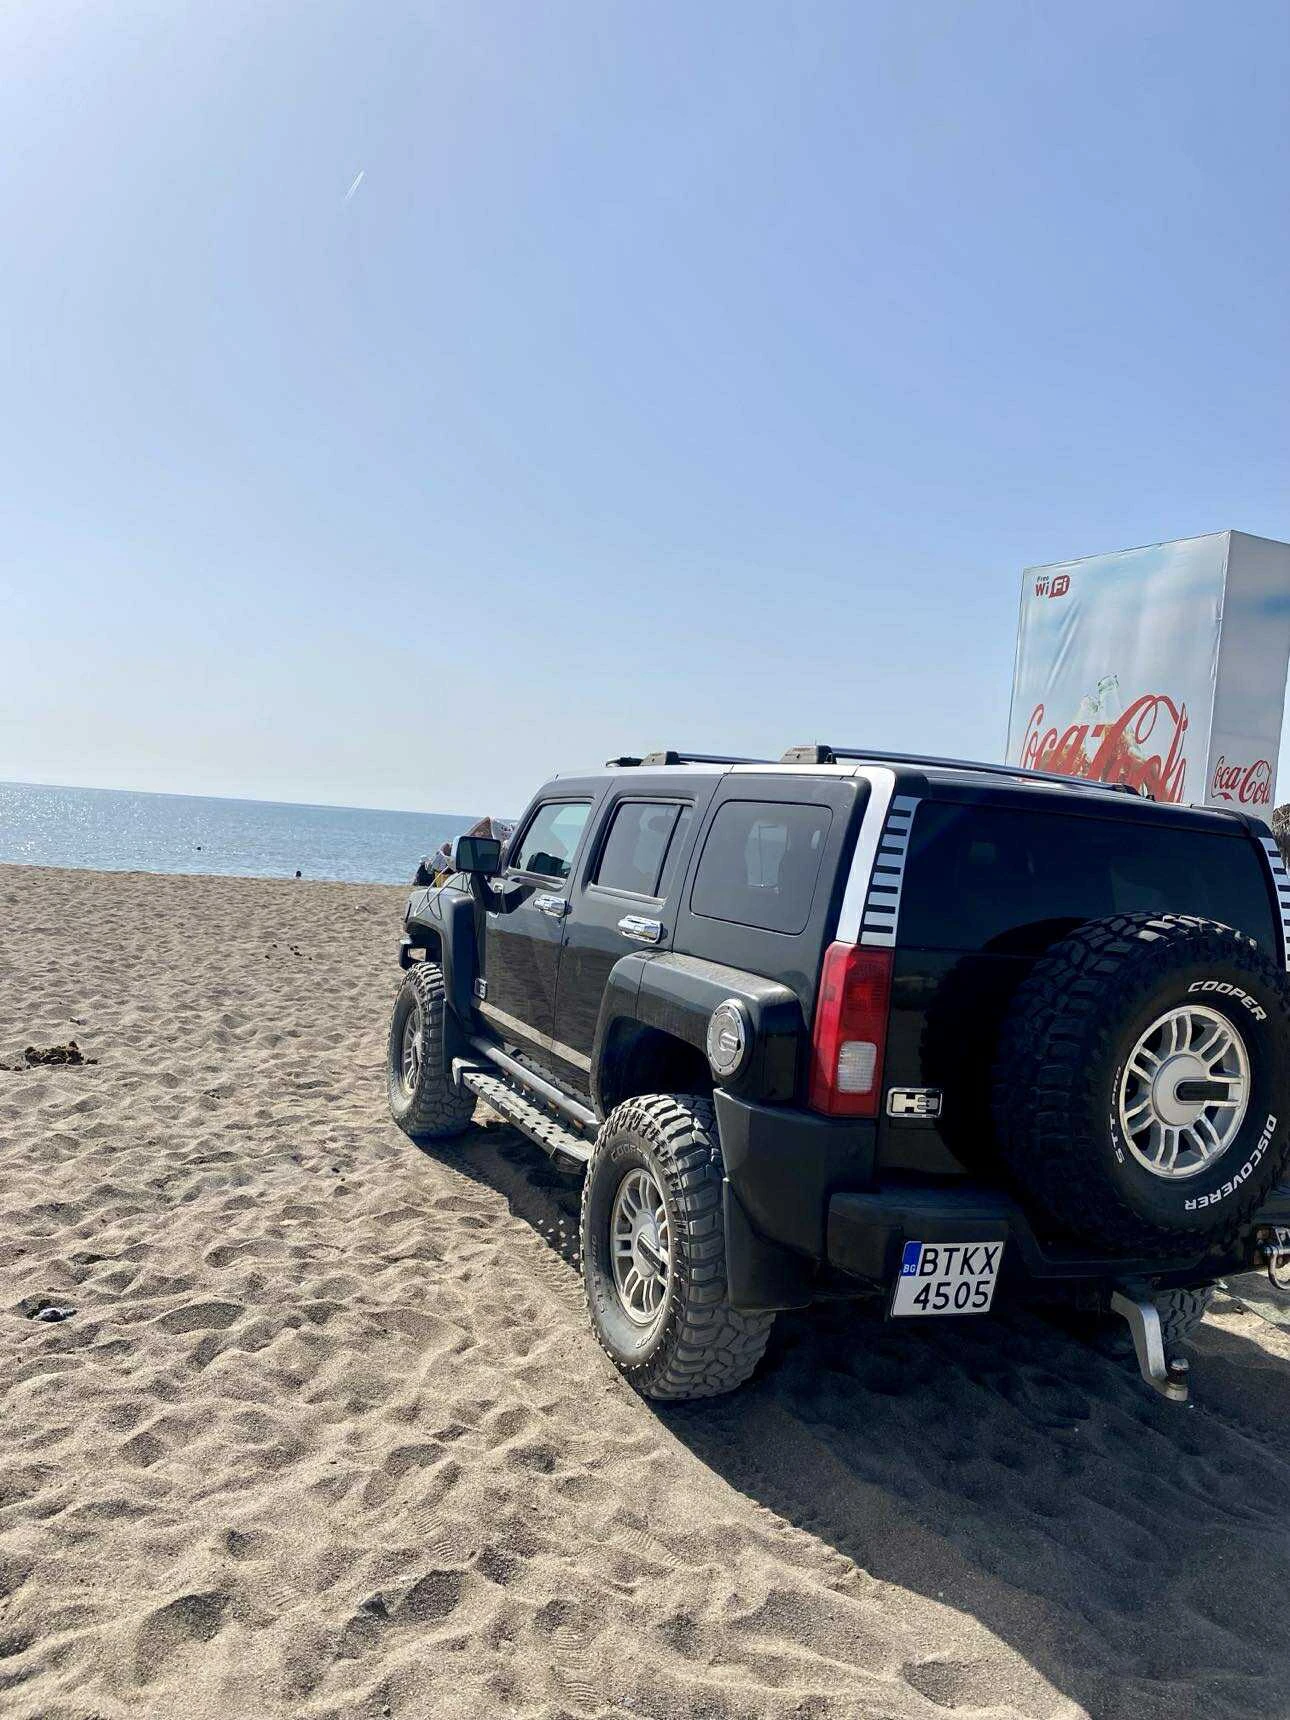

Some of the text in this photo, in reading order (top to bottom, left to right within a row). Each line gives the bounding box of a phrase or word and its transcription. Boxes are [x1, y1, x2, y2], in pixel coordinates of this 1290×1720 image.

[1187, 980, 1268, 1021] COOPER
[1184, 1114, 1278, 1211] DISCOVERER
[902, 1263, 916, 1273] BG
[918, 1246, 1000, 1277] BTKX
[912, 1280, 991, 1311] 4505
